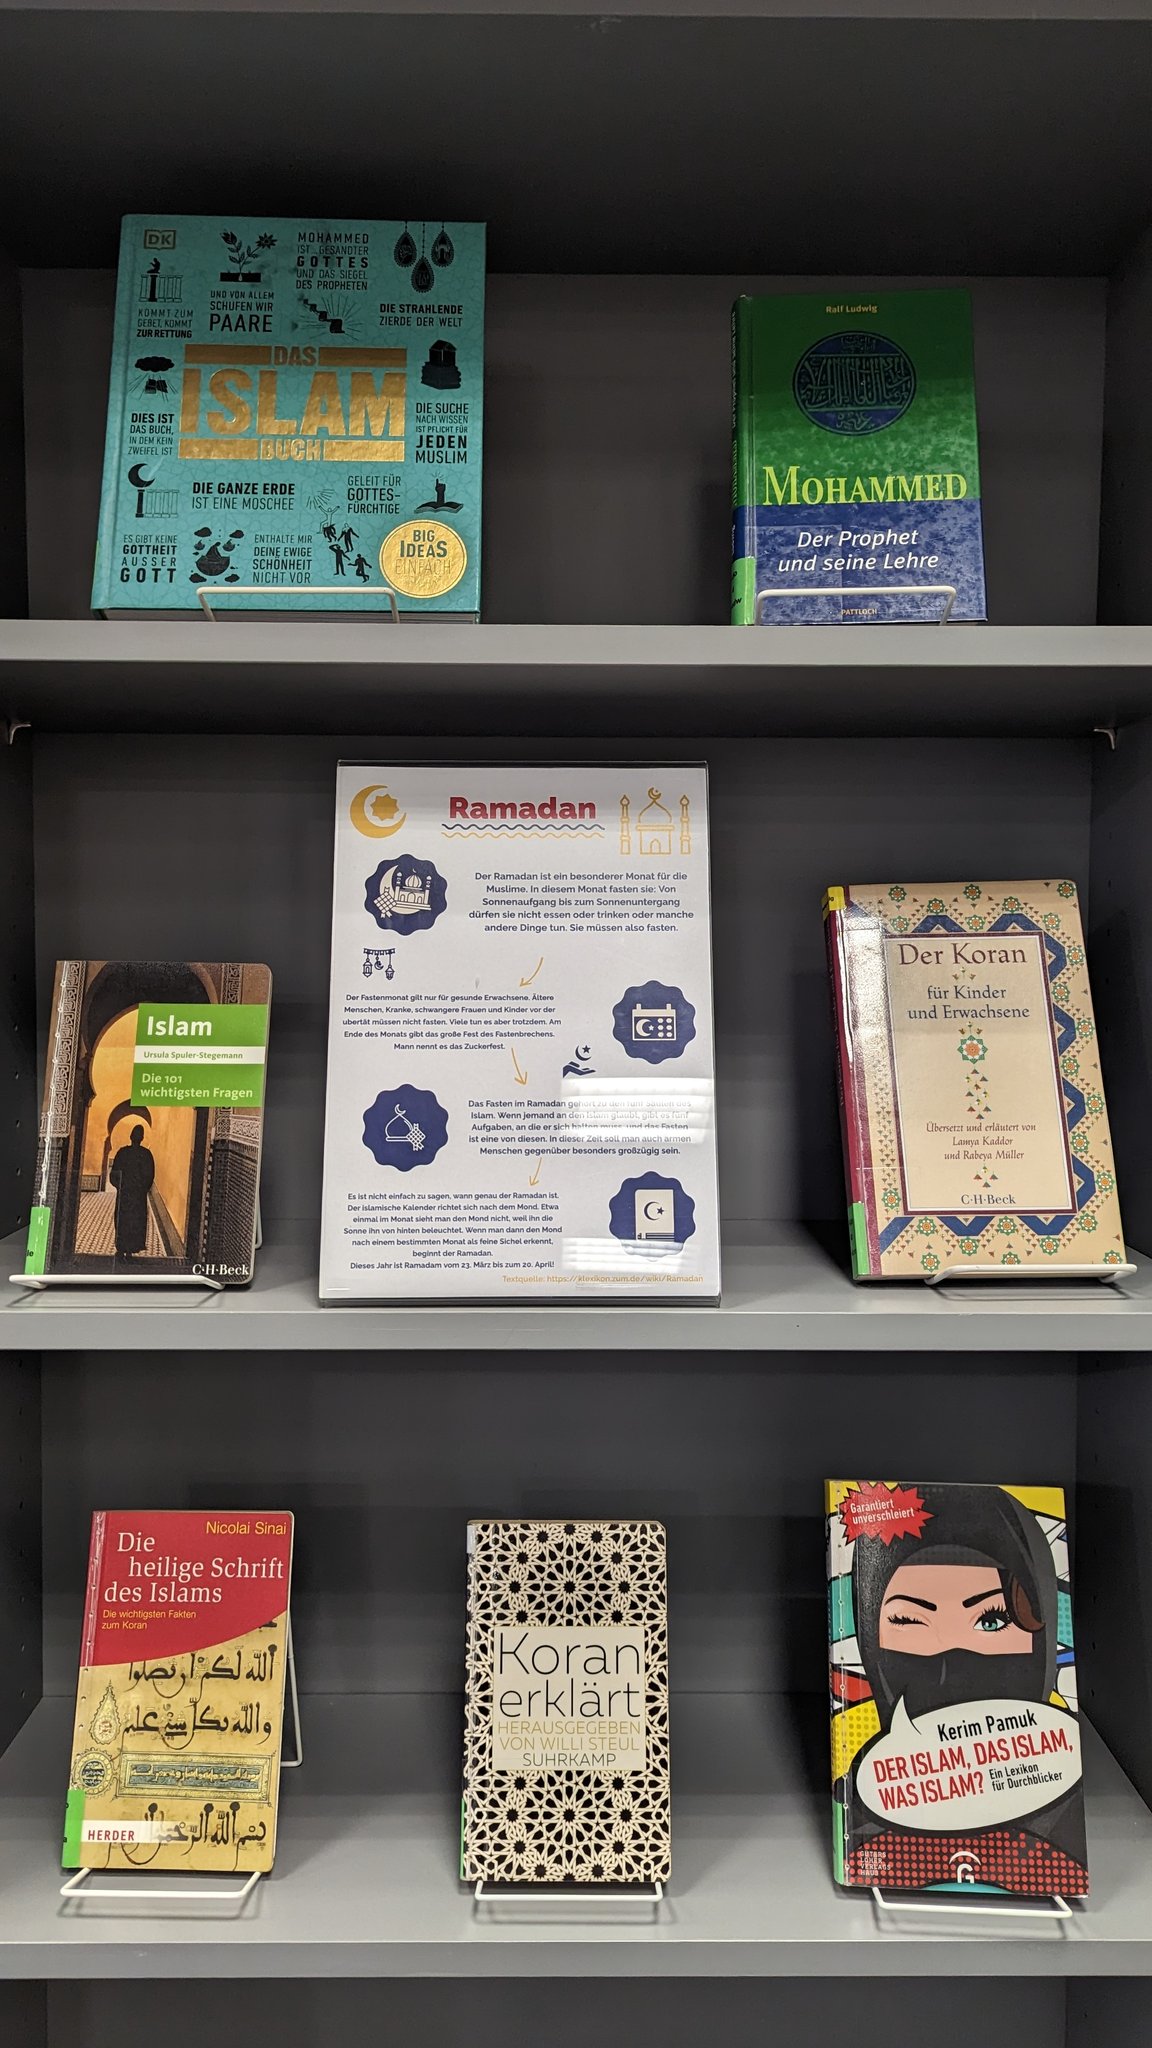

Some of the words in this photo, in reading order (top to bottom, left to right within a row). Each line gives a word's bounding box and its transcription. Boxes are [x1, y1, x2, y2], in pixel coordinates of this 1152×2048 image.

[148, 233, 171, 246] DK
[298, 232, 369, 244] MOHAMMED
[297, 256, 369, 268] GOTTES
[295, 280, 313, 290] DES
[317, 279, 368, 290] PROPHETEN
[210, 301, 251, 312] SCHUFEN
[255, 302, 273, 312] WIR
[380, 304, 395, 314] DIE
[399, 304, 463, 315] STRAHLENDE
[826, 305, 843, 313] Ralf
[846, 305, 877, 314] Ludwig
[209, 314, 273, 332] PAARE
[379, 315, 412, 326] ZIERDE
[416, 316, 434, 327] DER
[439, 316, 463, 327] WELT
[136, 329, 153, 338] ZUR
[154, 329, 192, 338] RETTUNG
[274, 346, 316, 366] DAS
[180, 368, 406, 436] ISLAM
[416, 403, 432, 414] DIE
[436, 403, 469, 414] SUCHE
[131, 413, 153, 423] DIES
[158, 413, 174, 423] IST
[130, 424, 146, 434] DAS
[150, 424, 174, 435] BUCH,
[416, 434, 468, 449] JEDEN
[261, 439, 321, 461] BUCH
[416, 451, 467, 464] MUSLIM
[193, 482, 214, 495] DIE
[218, 482, 259, 495] GANZE
[262, 483, 295, 495] ERDE
[763, 466, 967, 506] MOHAMMED
[192, 497, 210, 509] IST
[213, 498, 238, 509] EINE
[242, 498, 294, 510] MOSCHEE
[413, 530, 435, 542] BIG
[797, 531, 832, 548] Der
[838, 529, 919, 548] Prophet
[123, 545, 177, 555] GOTTHEIT
[252, 556, 313, 571] SCHÖNHEIT
[778, 556, 816, 572] und
[822, 555, 876, 571] seine
[884, 552, 939, 569] Lehre
[120, 568, 176, 583] GOTT
[450, 797, 596, 819] Ramadan
[475, 872, 492, 880] Der
[493, 872, 538, 881] Ramadan
[540, 872, 551, 881] ist
[553, 872, 568, 881] ein
[569, 872, 624, 881] besonderer
[626, 872, 655, 881] Monat
[657, 872, 671, 881] für
[672, 872, 687, 880] die
[486, 885, 528, 893] Muslime.
[530, 885, 539, 893] In
[541, 885, 576, 894] diesem
[578, 885, 607, 894] Monat
[609, 885, 639, 893] fasten
[640, 885, 656, 893] sie:
[658, 885, 676, 893] Von
[899, 943, 944, 965] Der
[953, 943, 1026, 964] Koran
[927, 986, 949, 999] für
[954, 986, 1006, 999] Kinder
[908, 1005, 937, 1019] und
[943, 1005, 1029, 1018] Erwachsene
[147, 1015, 212, 1037] Islam
[144, 1051, 169, 1059] Ursula
[171, 1052, 243, 1060] Spuler-Stegemann
[142, 1073, 161, 1083] Die
[165, 1075, 182, 1083] 101
[141, 1087, 209, 1099] wichtigsten
[213, 1087, 253, 1099] Fragen
[926, 1121, 964, 1132] Übersetzt
[966, 1122, 983, 1131] und
[985, 1121, 1019, 1132] erläutert
[952, 1136, 980, 1148] Lamya
[982, 1136, 1013, 1146] Kaddor
[944, 1150, 961, 1160] und
[963, 1150, 993, 1161] Rabeya
[996, 1150, 1024, 1160] Müller
[412, 1250, 441, 1259] beginnt
[473, 1261, 491, 1269] März
[534, 1261, 554, 1269] April!
[850, 1499, 894, 1514] Garantiert
[852, 1508, 915, 1524] unverschleiert
[206, 1521, 250, 1535] Nicolai
[255, 1522, 286, 1535] Sinai
[118, 1532, 155, 1553] Die
[129, 1556, 204, 1583] heilige
[211, 1557, 284, 1578] Schrift
[104, 1581, 142, 1602] des
[150, 1581, 222, 1603] Islams
[103, 1609, 117, 1619] Die
[119, 1609, 166, 1621] wichtigsten
[169, 1609, 196, 1618] Fakten
[122, 1620, 147, 1630] Koran
[499, 1632, 640, 1675] Koran
[499, 1678, 640, 1718] erklärt
[498, 1721, 640, 1734] HERAUSGEGEBEN
[937, 1719, 982, 1742] Kerim
[985, 1709, 1037, 1733] Pamuk
[500, 1737, 536, 1750] VON
[541, 1737, 584, 1750] WILLI
[588, 1737, 639, 1751] STEUL
[522, 1754, 616, 1766] SUHRKAMP
[873, 1757, 909, 1783] DER
[911, 1747, 971, 1776] ISLAM,
[974, 1741, 1009, 1766] DAS
[1011, 1729, 1073, 1760] ISLAM,
[990, 1768, 1002, 1779] Ein
[1004, 1763, 1039, 1777] Lexikon
[992, 1780, 1004, 1791] für
[1007, 1771, 1062, 1789] Durchblicker
[879, 1783, 921, 1810] WAS
[921, 1772, 984, 1802] ISLAM?
[88, 1829, 135, 1840] HERDER
